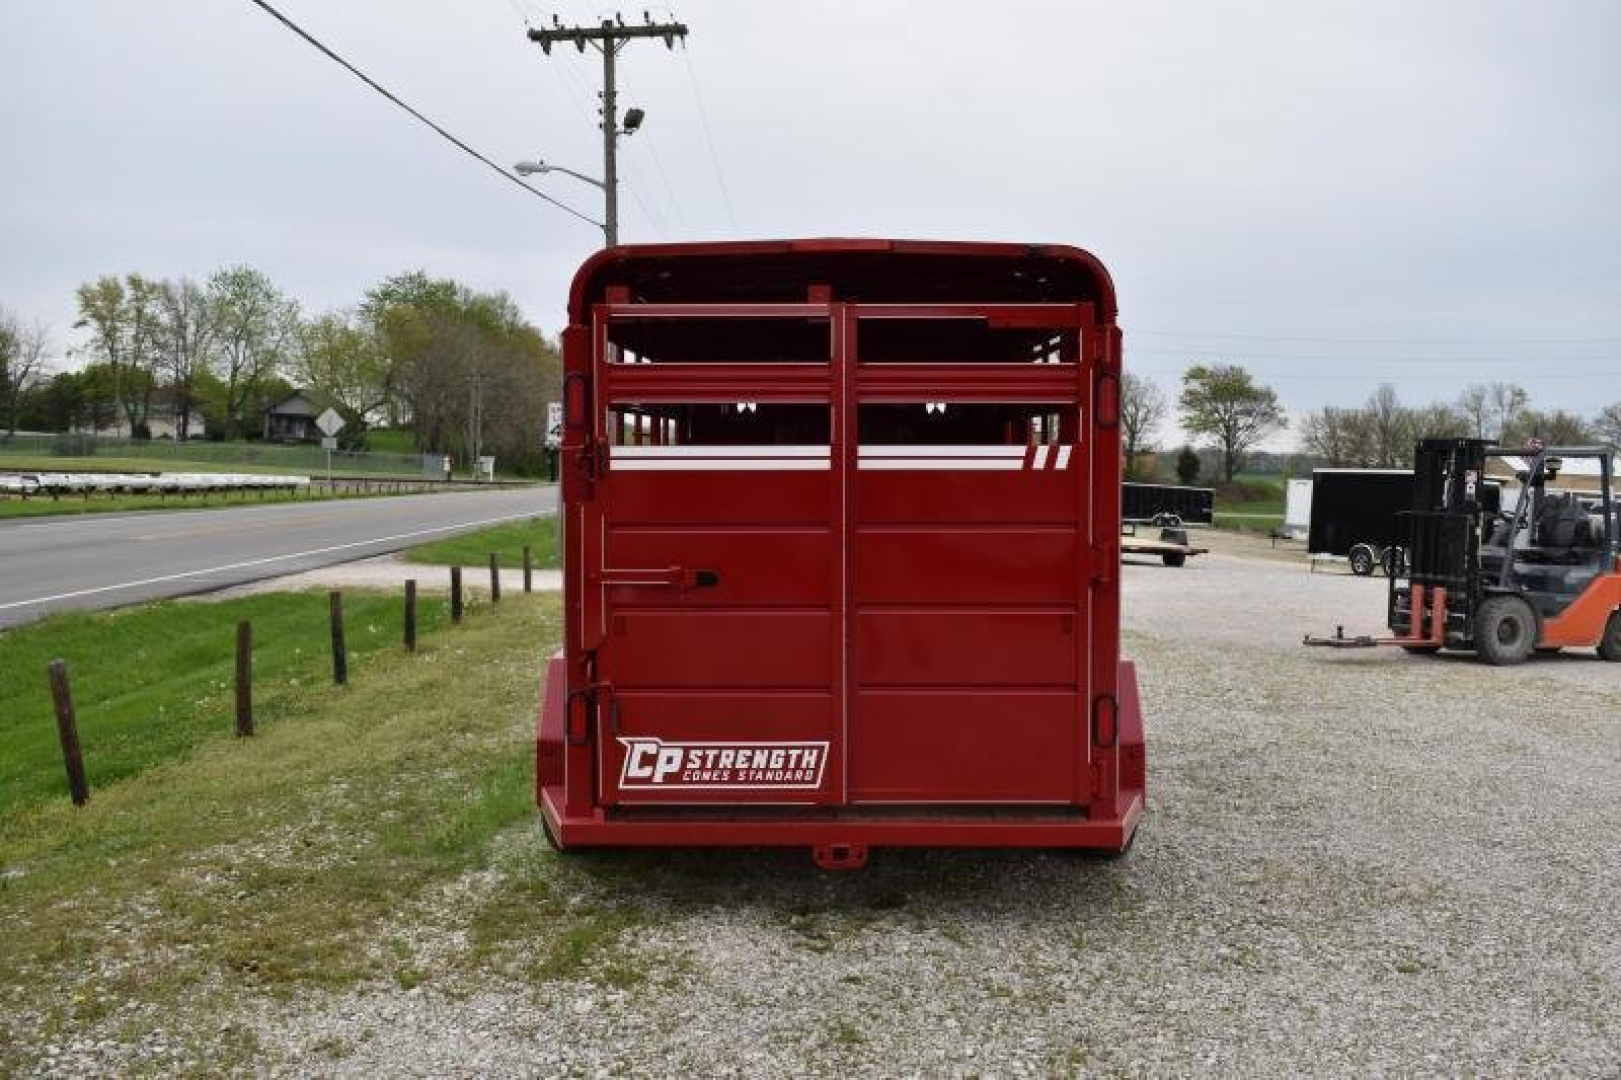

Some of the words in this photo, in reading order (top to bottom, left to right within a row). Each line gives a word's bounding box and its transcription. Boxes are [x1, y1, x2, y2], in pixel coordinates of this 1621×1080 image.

[627, 743, 683, 783] CP
[686, 749, 818, 769] STRENGTH
[682, 770, 730, 781] COMES
[738, 770, 814, 781] STANDARD
